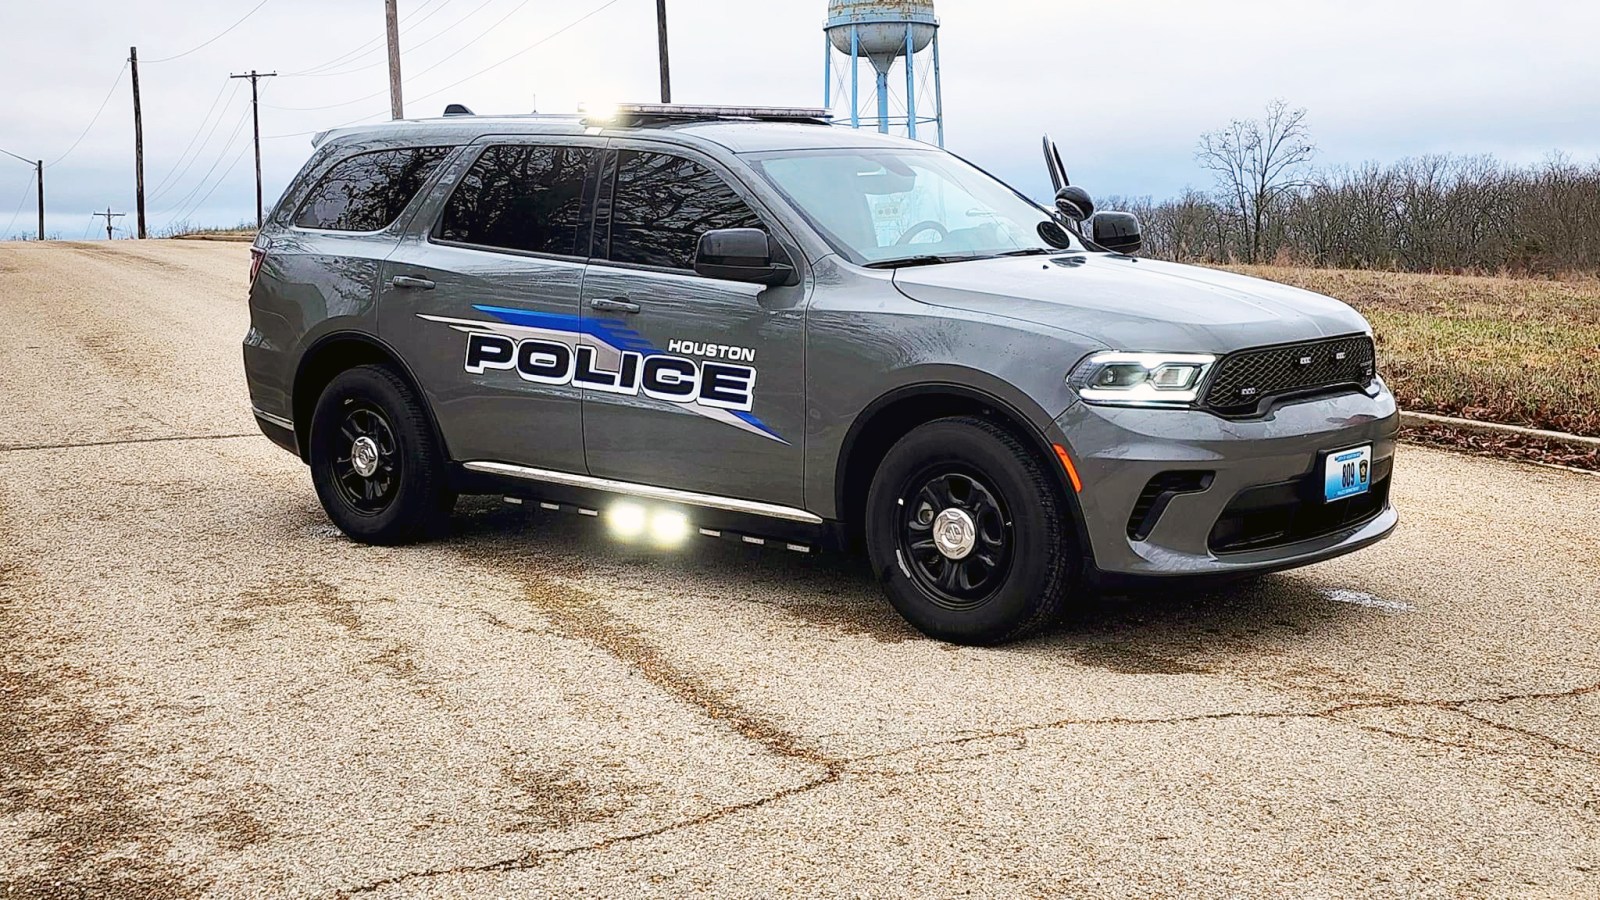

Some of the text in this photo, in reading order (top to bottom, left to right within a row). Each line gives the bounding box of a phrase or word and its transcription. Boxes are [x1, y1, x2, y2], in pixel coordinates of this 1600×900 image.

[668, 339, 756, 362] HOUSTON
[465, 332, 757, 412] POLICE
[1342, 462, 1355, 487] 809
